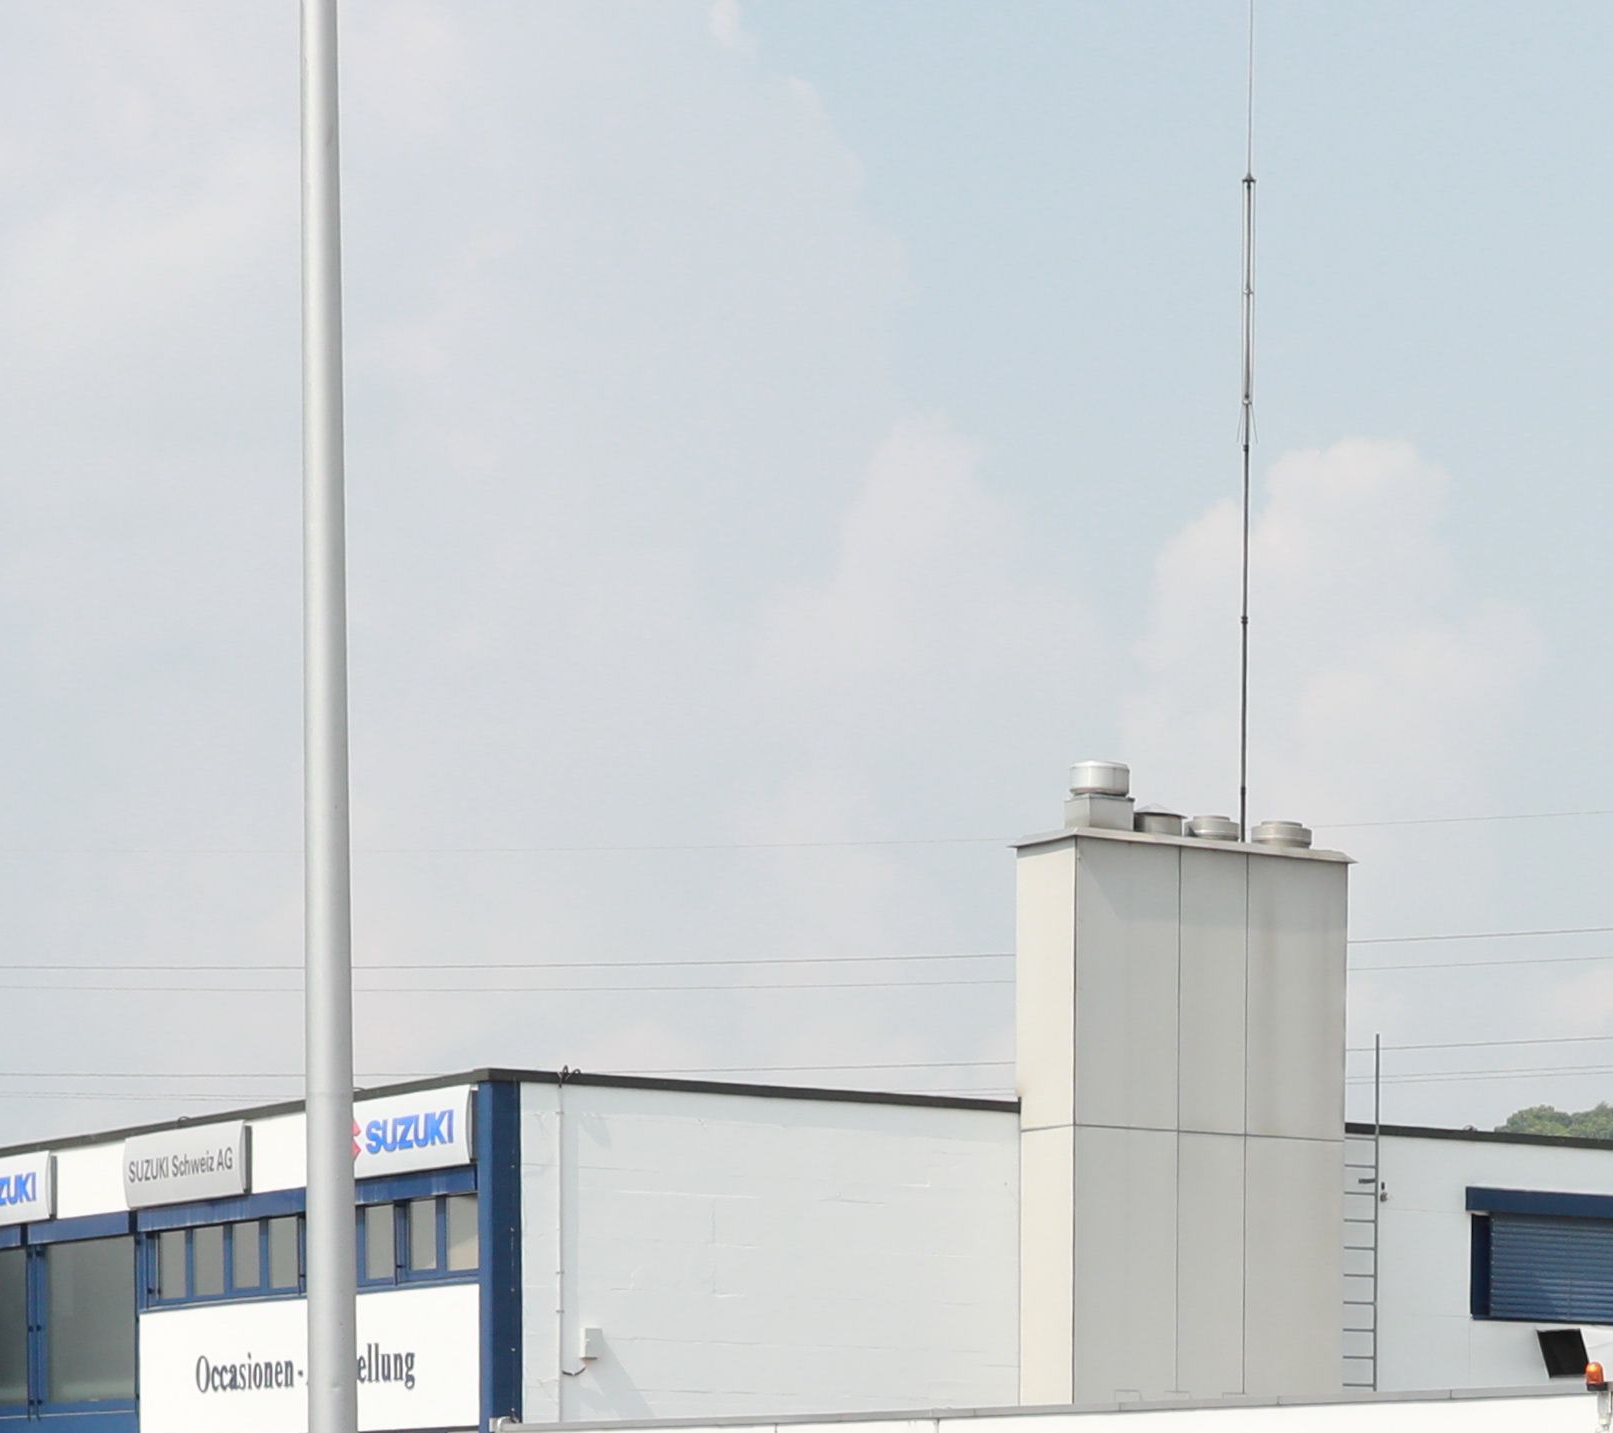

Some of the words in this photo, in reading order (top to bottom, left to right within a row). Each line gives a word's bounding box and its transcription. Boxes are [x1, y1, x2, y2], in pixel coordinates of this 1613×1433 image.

[366, 1109, 454, 1154] SUZUKI
[129, 1156, 170, 1183] SUZUKI
[172, 1151, 215, 1179] Schweiz
[217, 1147, 233, 1171] AG
